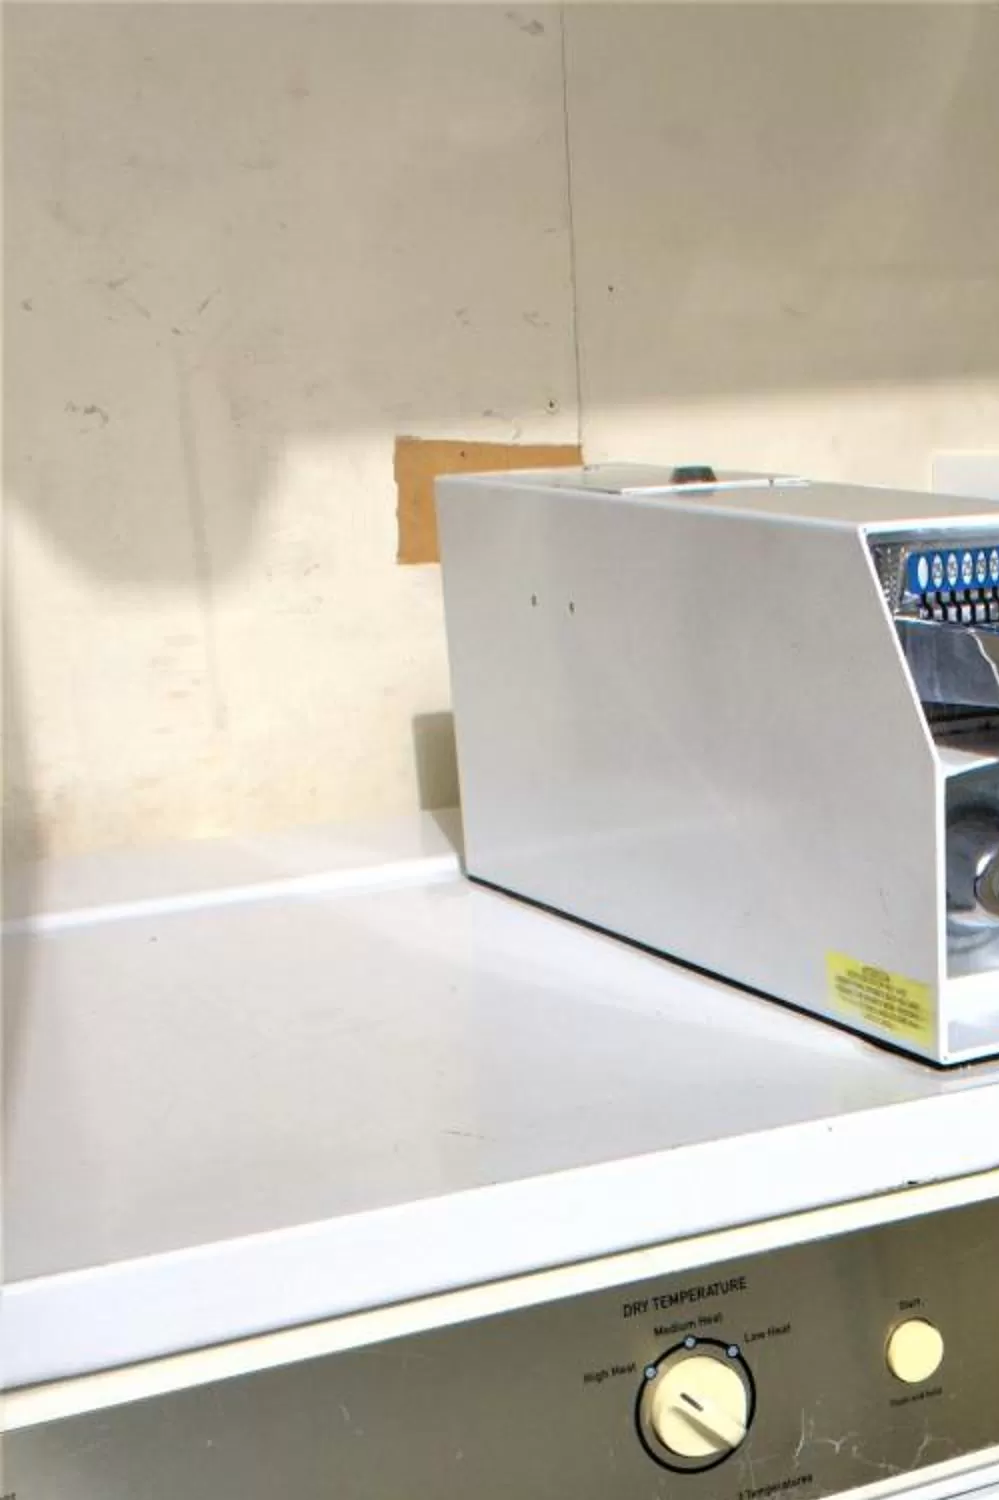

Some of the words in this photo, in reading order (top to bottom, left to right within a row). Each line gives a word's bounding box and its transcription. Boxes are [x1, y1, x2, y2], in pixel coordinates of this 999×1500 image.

[623, 1301, 649, 1319] DRY
[651, 1275, 748, 1312] TEMPERATURE
[653, 1316, 697, 1337] Medium
[698, 1311, 723, 1328] Heat
[744, 1330, 766, 1345] Low
[767, 1321, 792, 1338] Heat
[583, 1366, 610, 1385] High
[611, 1361, 638, 1378] Heat
